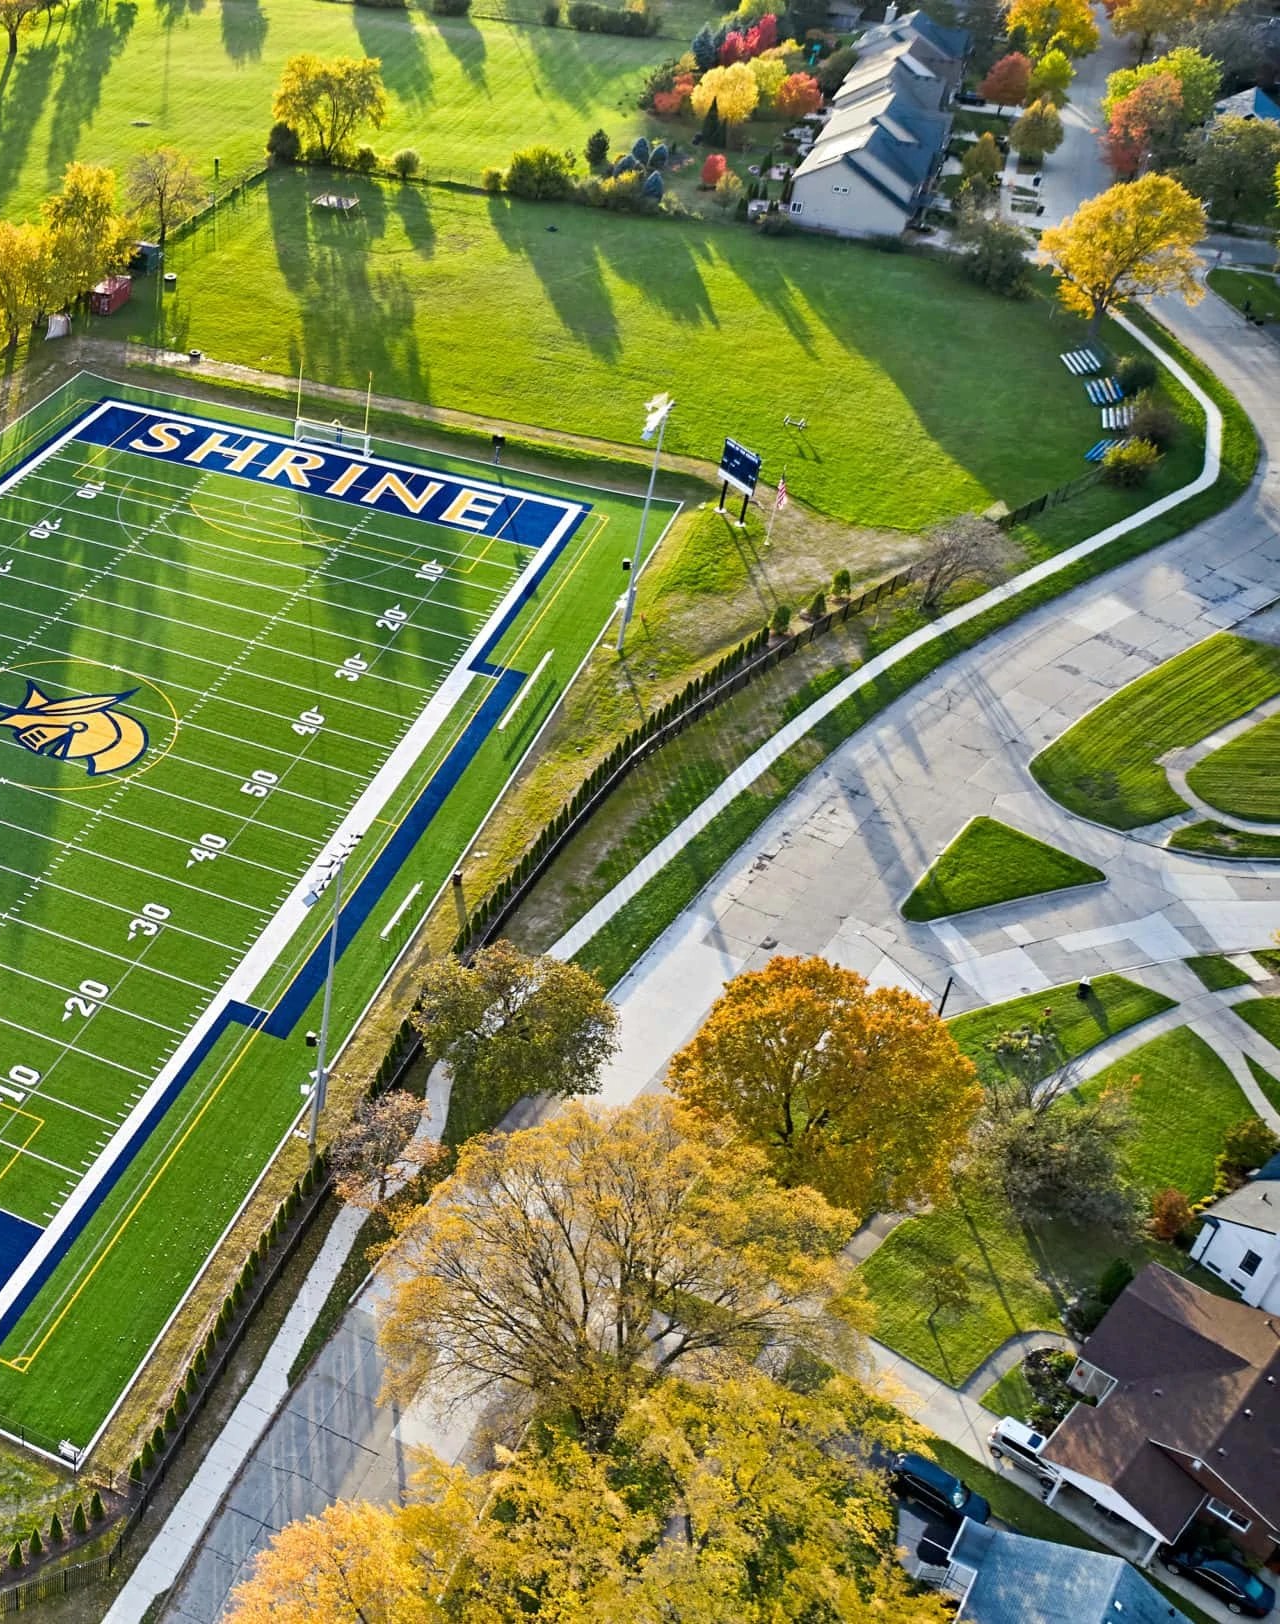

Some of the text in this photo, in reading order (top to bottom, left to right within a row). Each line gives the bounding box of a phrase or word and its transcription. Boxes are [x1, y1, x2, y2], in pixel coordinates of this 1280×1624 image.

[129, 422, 508, 531] SHRINE
[76, 482, 105, 499] 10
[29, 519, 61, 539] 20
[415, 563, 444, 582] 10
[375, 608, 407, 632] 20
[334, 657, 368, 682] 30
[291, 711, 325, 736] 40
[240, 769, 278, 798] 50
[189, 833, 228, 862] 40
[129, 903, 172, 936] 30
[64, 979, 110, 1018] 20
